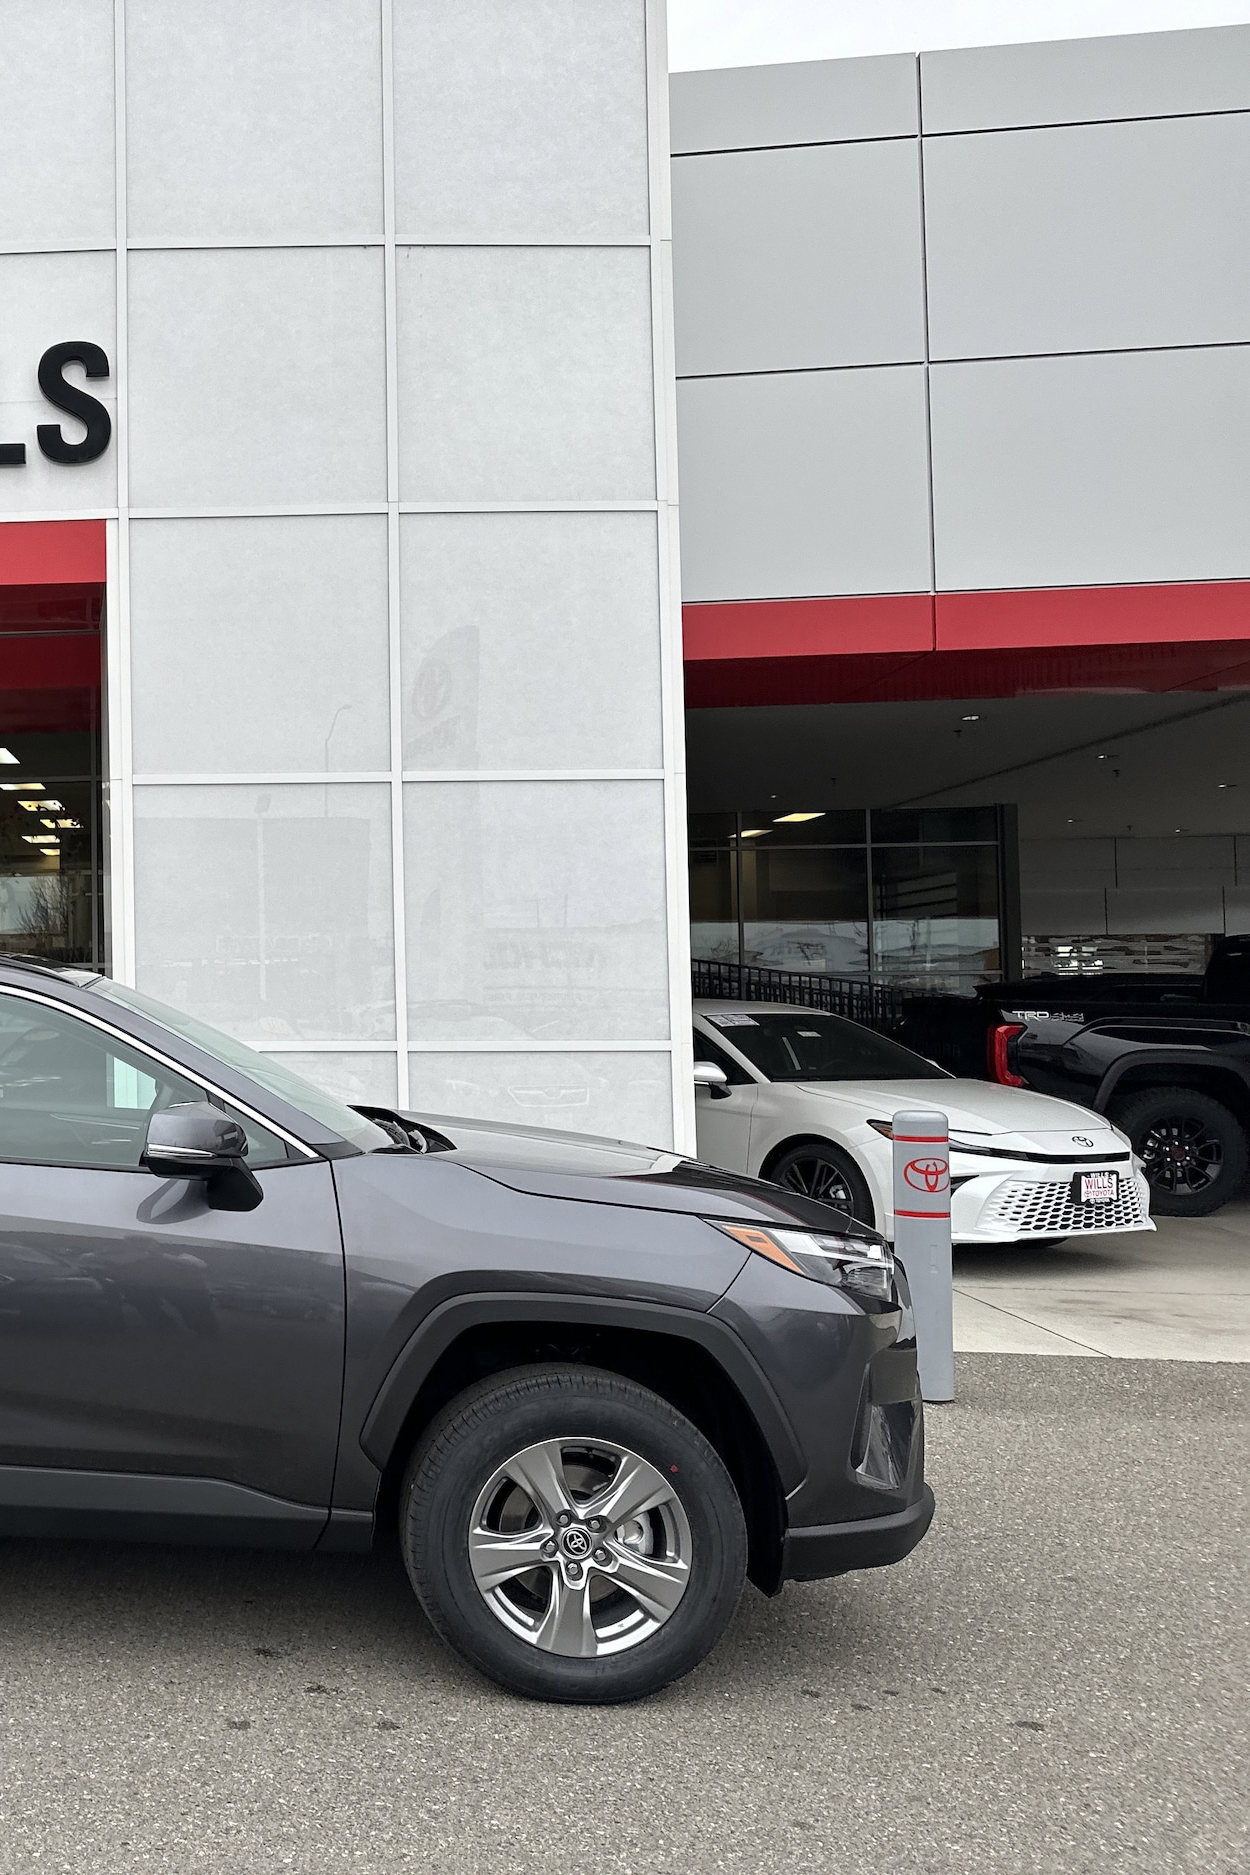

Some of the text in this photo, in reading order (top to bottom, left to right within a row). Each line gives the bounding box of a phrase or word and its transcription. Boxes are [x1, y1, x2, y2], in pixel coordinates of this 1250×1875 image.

[1012, 1010, 1050, 1021] TRD
[1084, 1178, 1113, 1189] WILLS
[1092, 1189, 1114, 1197] TOYOTA
